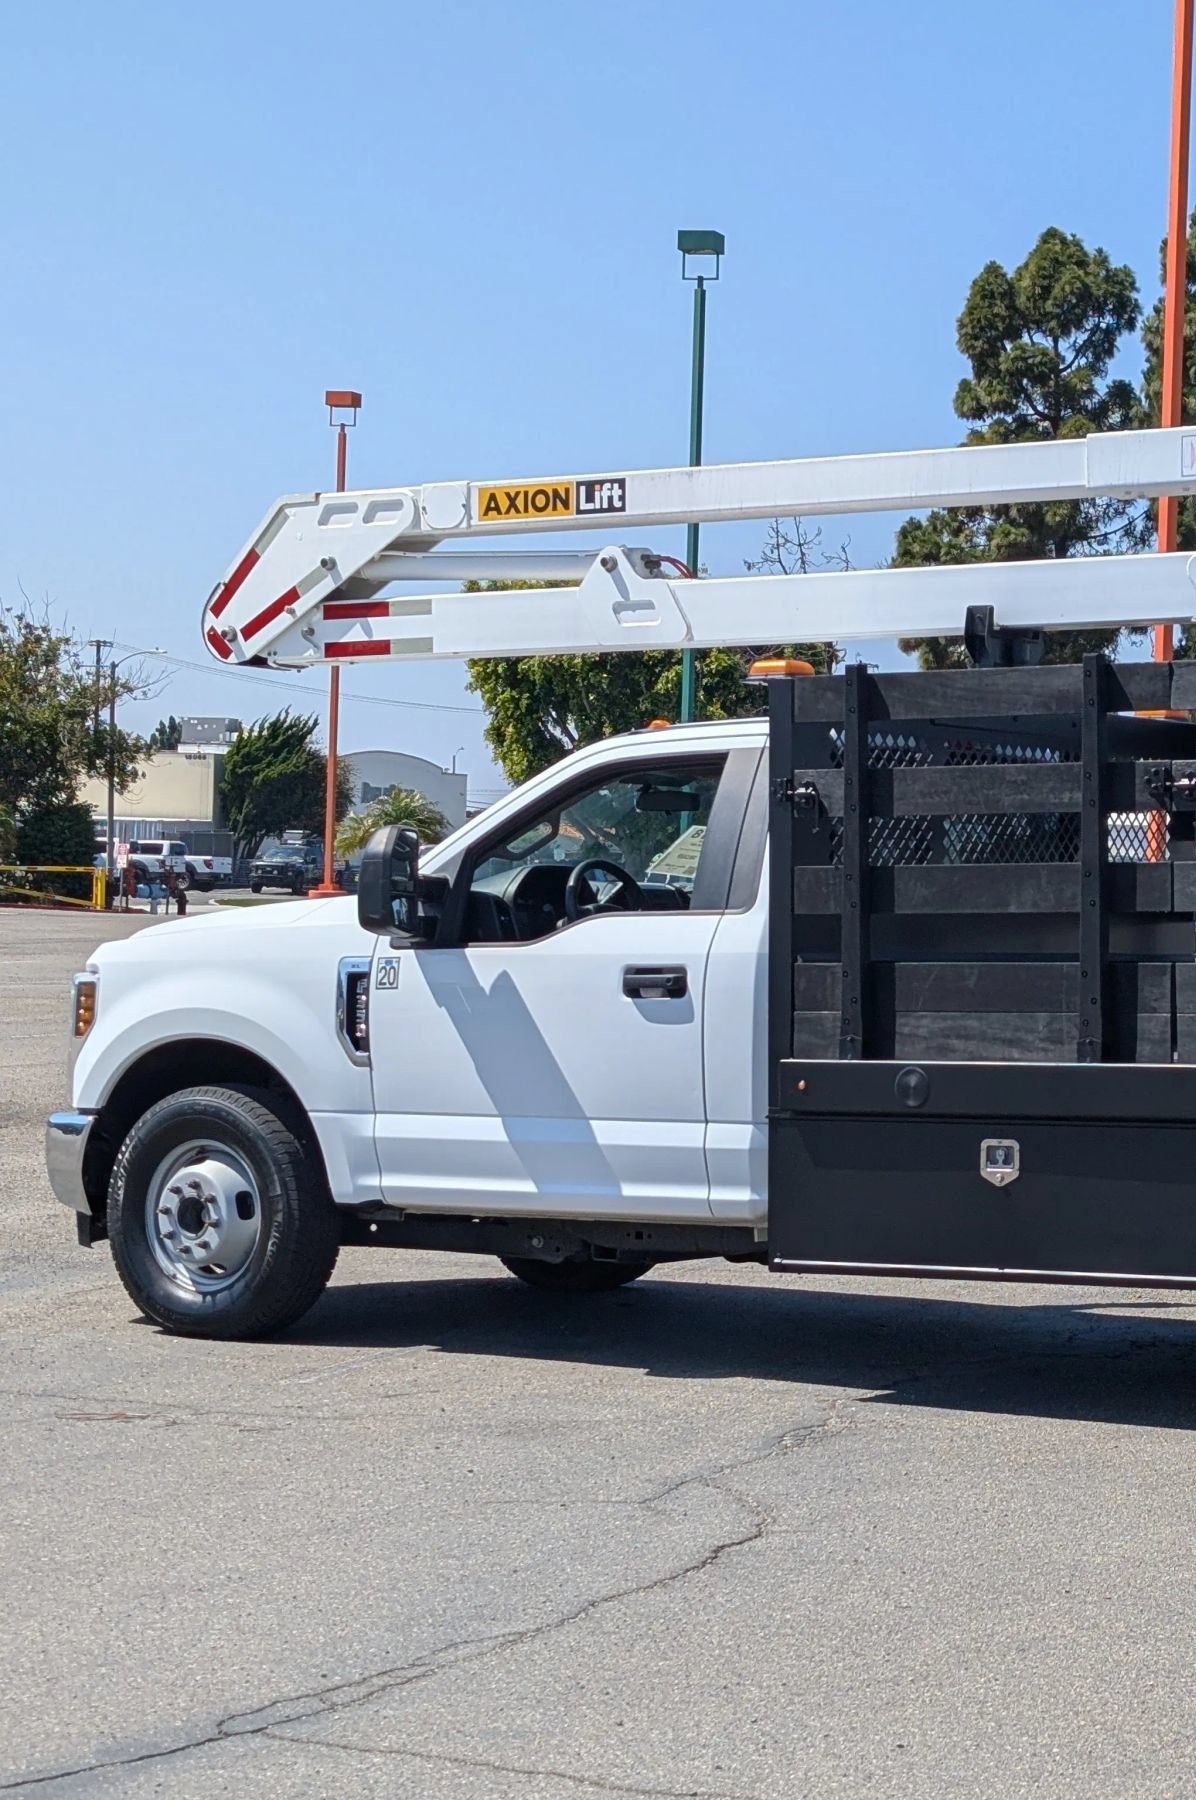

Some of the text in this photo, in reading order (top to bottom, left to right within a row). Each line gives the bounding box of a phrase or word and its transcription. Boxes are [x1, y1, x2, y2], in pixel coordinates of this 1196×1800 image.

[482, 482, 623, 517] AXION Lift
[378, 965, 397, 986] 20
